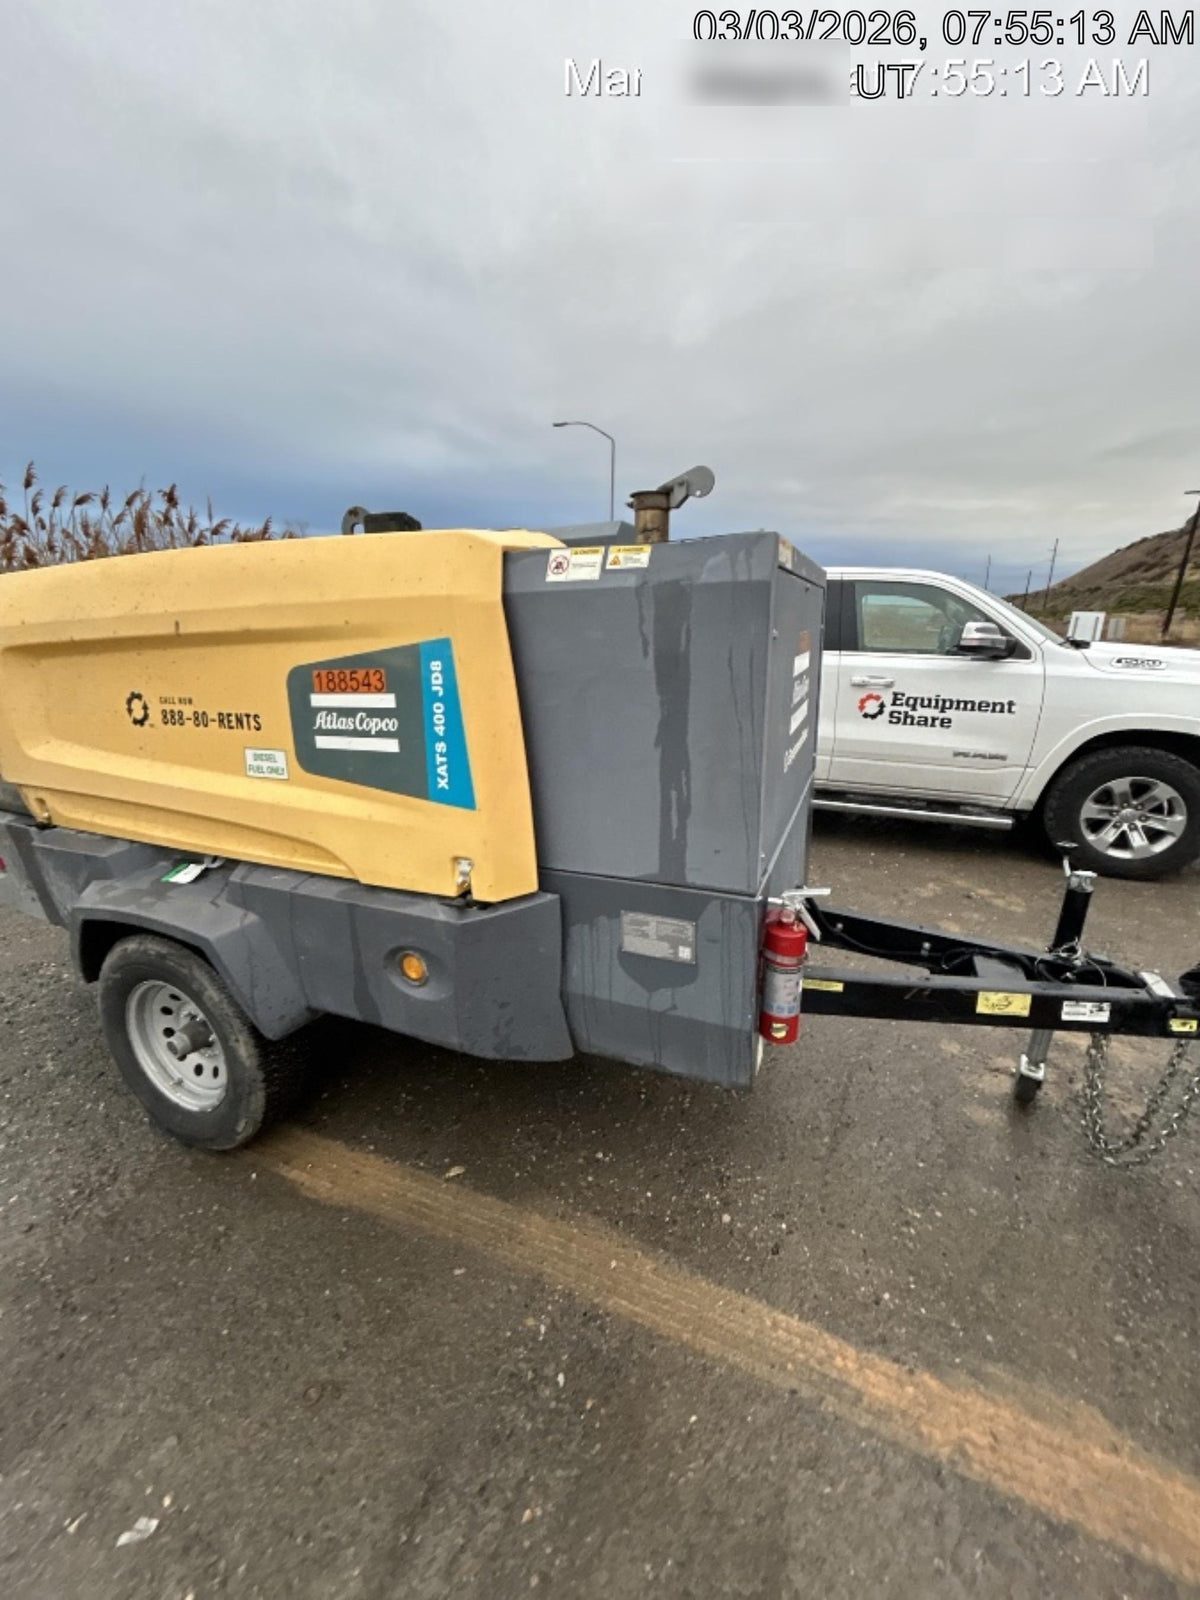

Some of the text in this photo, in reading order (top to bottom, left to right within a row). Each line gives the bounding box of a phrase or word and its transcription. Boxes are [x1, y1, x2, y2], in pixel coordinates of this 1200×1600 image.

[315, 669, 385, 693] 188543
[890, 691, 1017, 714] Equipment
[161, 708, 262, 732] 888-80-RENTS
[430, 660, 449, 790] XATS 400 JD8
[888, 710, 952, 729] Share
